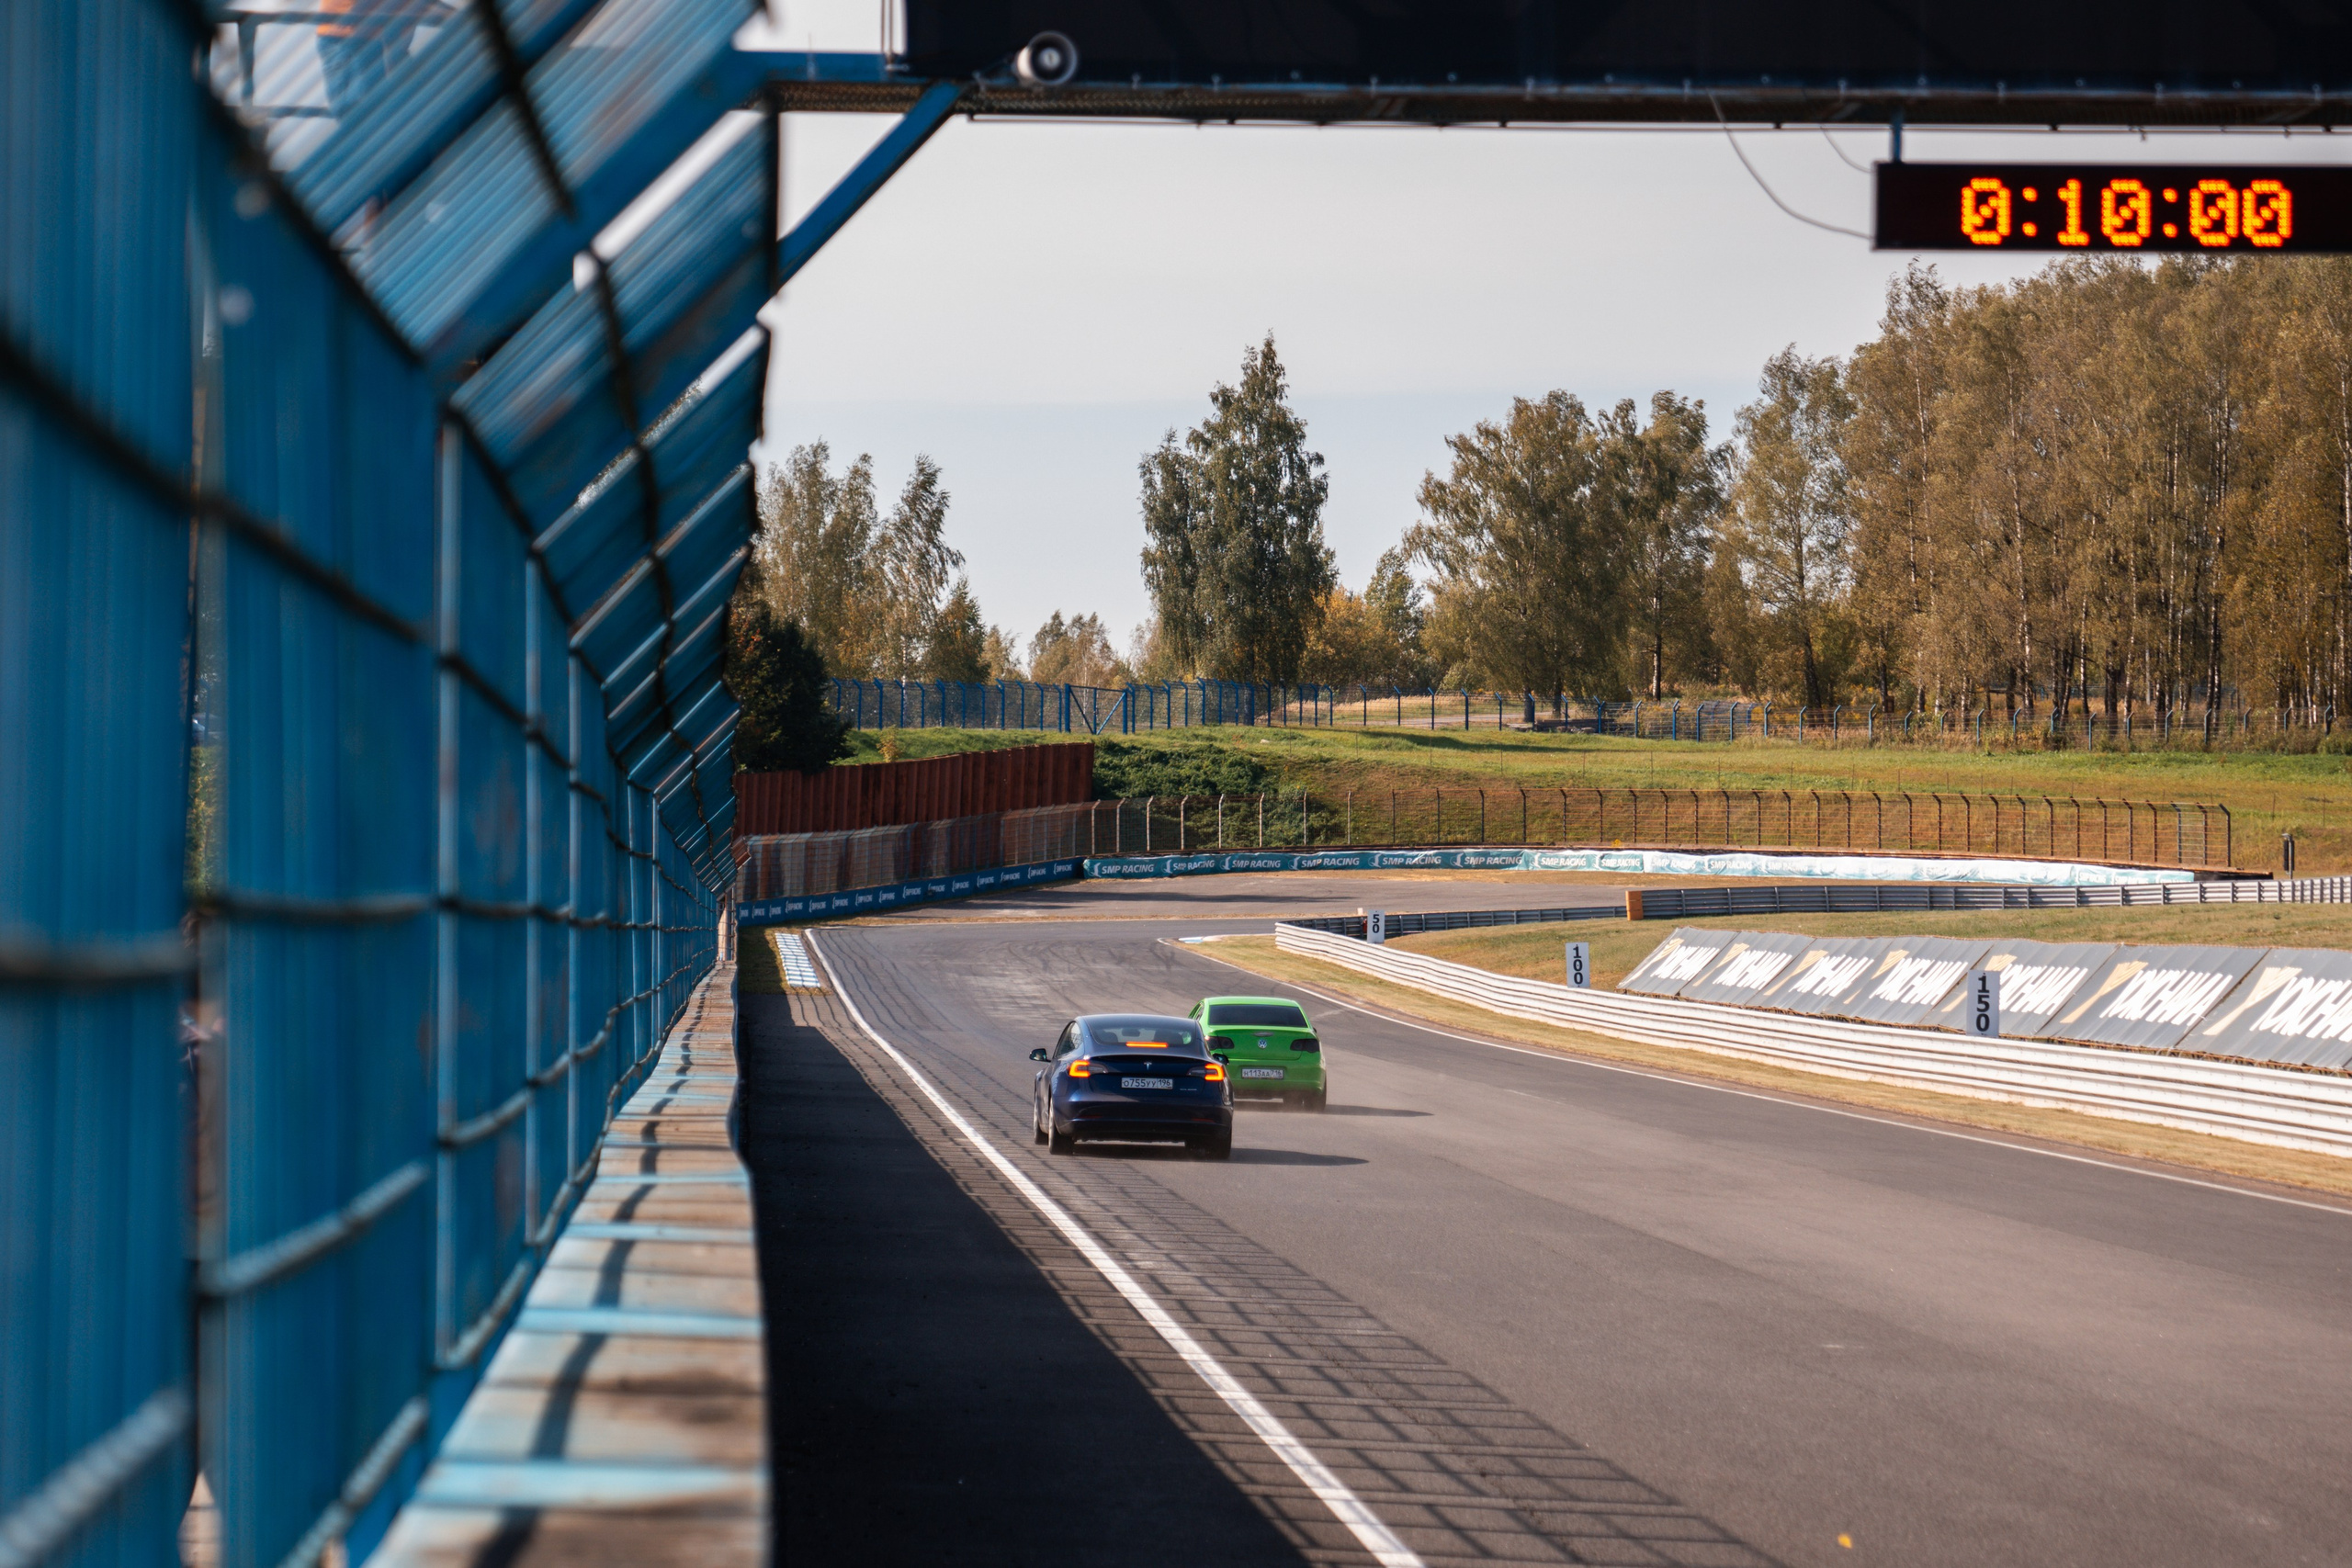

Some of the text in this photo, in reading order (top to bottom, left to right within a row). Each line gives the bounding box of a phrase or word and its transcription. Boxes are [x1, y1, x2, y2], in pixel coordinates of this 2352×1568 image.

[1961, 177, 2293, 248] 0:10:00
[1102, 863, 1154, 874] SMP RACING
[1231, 859, 1281, 868] SMP RACING
[1300, 857, 1360, 868] SMP RACING
[1382, 856, 1442, 866] SMP RACING
[1463, 856, 1522, 865] SMP RACING
[1372, 913, 1381, 934] 50
[1572, 945, 1584, 986] 100
[1975, 974, 1991, 1032] 150
[2098, 969, 2233, 1027] YOKOHAMA
